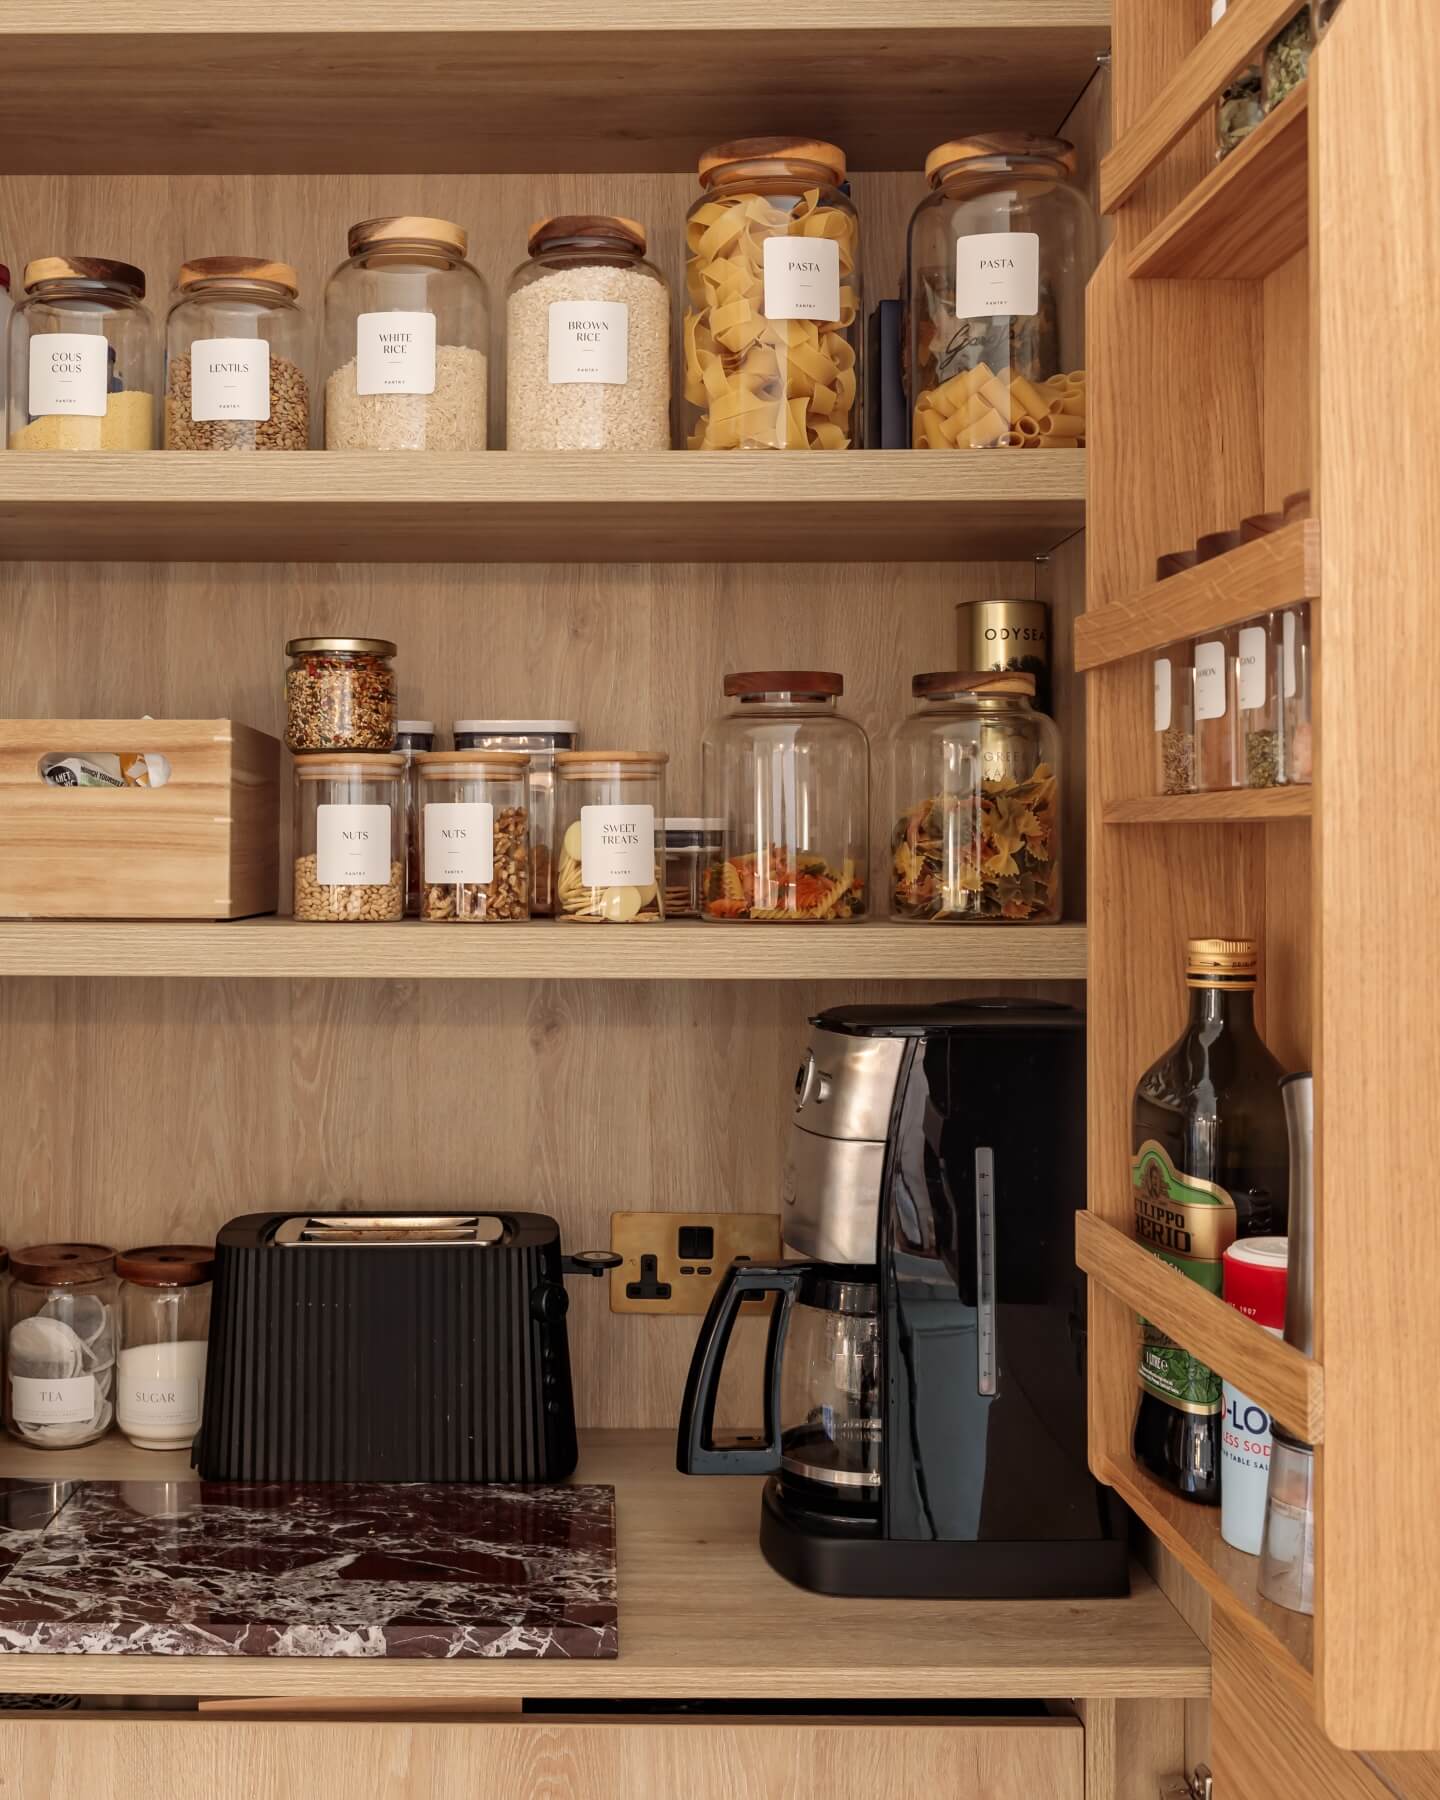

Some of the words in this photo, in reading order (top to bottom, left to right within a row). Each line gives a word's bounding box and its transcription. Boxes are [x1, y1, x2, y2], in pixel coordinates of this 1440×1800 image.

[788, 262, 821, 273] PASTA
[980, 258, 1015, 270] PASTA
[568, 320, 609, 331] BROWN
[378, 333, 413, 343] WHITE
[576, 332, 601, 342] RICE
[383, 344, 407, 354] RICE
[51, 352, 82, 362] COUS
[51, 363, 82, 373] COUS
[209, 363, 249, 373] LENTILS
[603, 823, 637, 833] SWEET
[342, 831, 369, 841] NUTS
[441, 829, 467, 840] NUTS
[601, 834, 639, 845] TREATS
[40, 1391, 63, 1402] TEA
[135, 1391, 176, 1403] SUGAR
